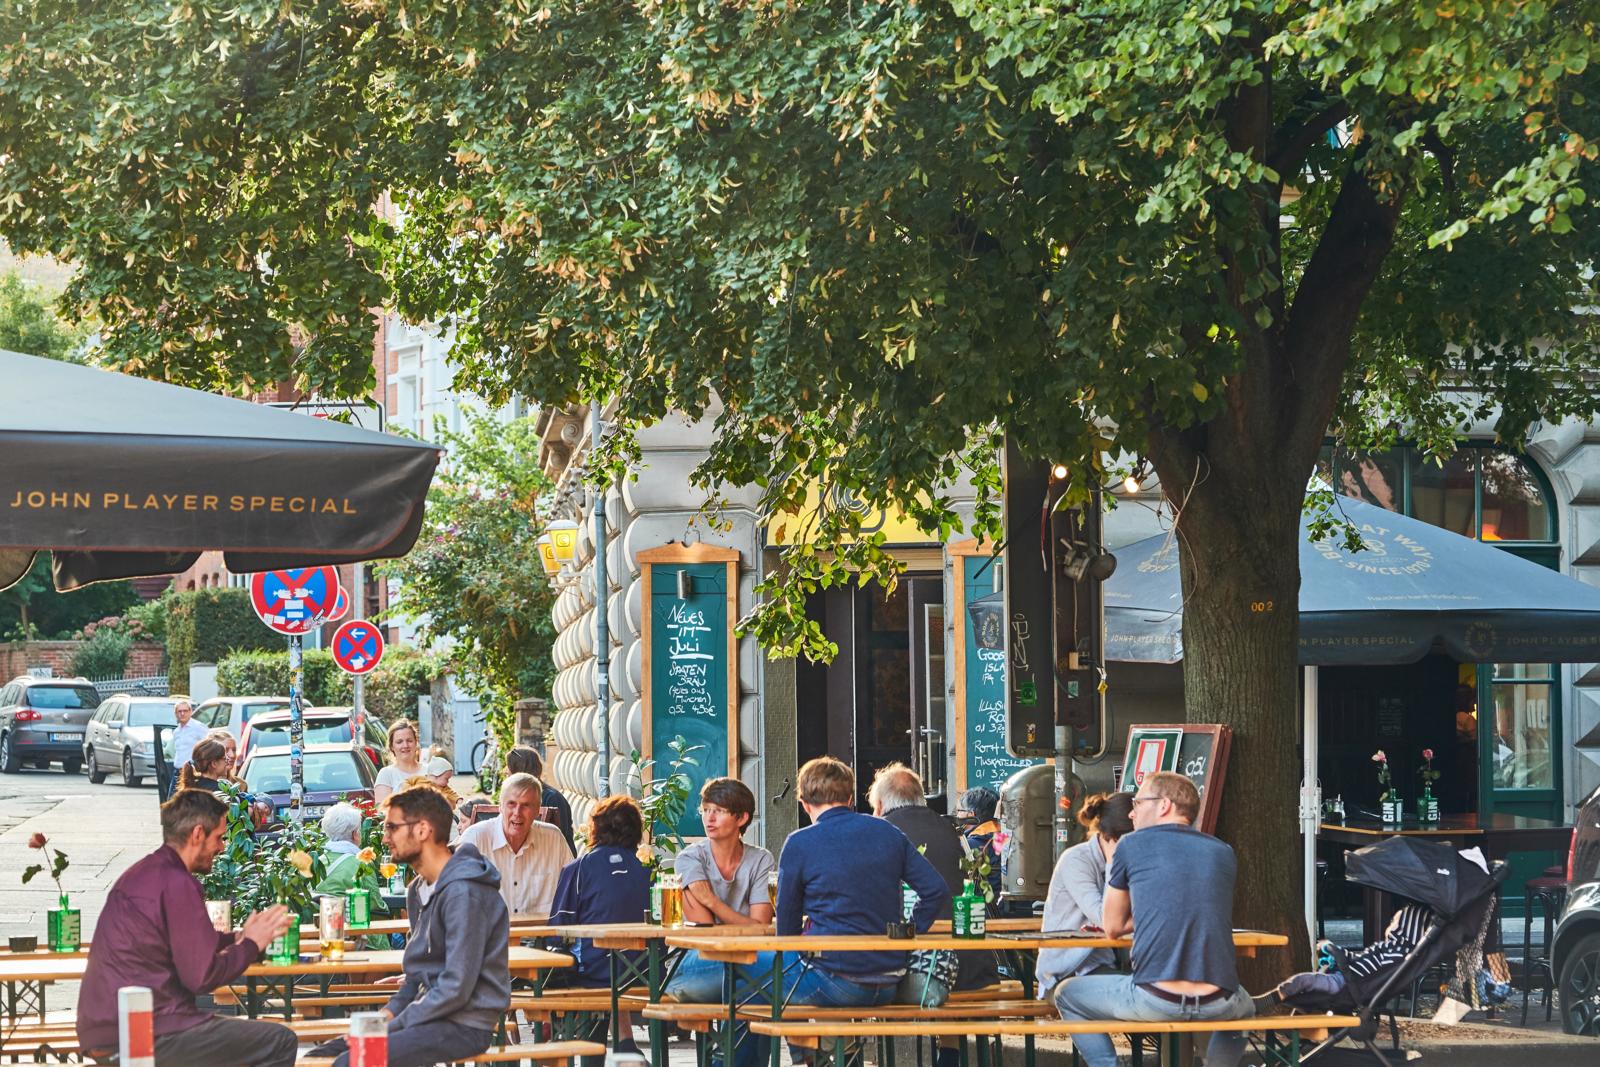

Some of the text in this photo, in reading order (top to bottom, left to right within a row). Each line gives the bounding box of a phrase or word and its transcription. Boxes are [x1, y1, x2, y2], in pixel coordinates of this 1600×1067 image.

[10, 491, 358, 514] JOHN PLAYER SPECIAL
[1345, 561, 1402, 575] SINCE
[1312, 637, 1360, 646] PLAYER
[1362, 636, 1416, 646] SPECIAL
[977, 648, 1005, 661] GOOS
[985, 662, 1005, 672] ISLA
[979, 699, 1004, 712] ILLUSI
[988, 711, 1005, 723] RO
[1383, 802, 1394, 822] GIN
[1428, 801, 1438, 821] GIN
[970, 902, 986, 935] GIN
